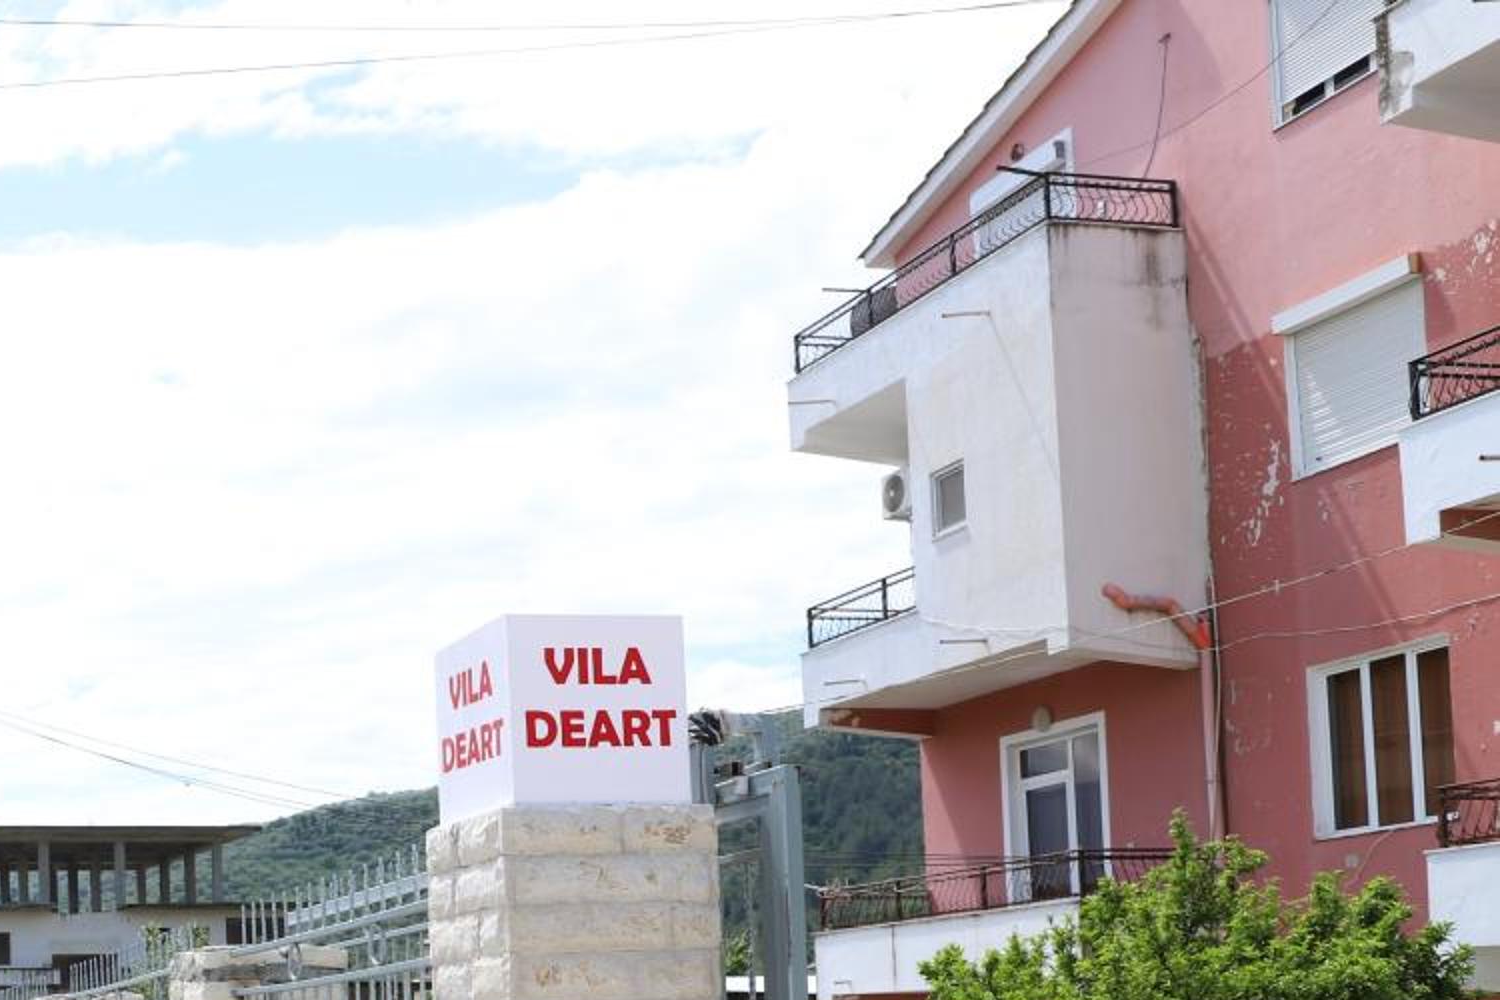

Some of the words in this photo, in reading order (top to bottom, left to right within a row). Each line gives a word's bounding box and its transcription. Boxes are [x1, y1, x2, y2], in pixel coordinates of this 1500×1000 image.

[449, 660, 493, 710] VILA
[543, 647, 651, 685] VILA
[442, 717, 504, 773] DEART
[525, 709, 677, 748] DEART
